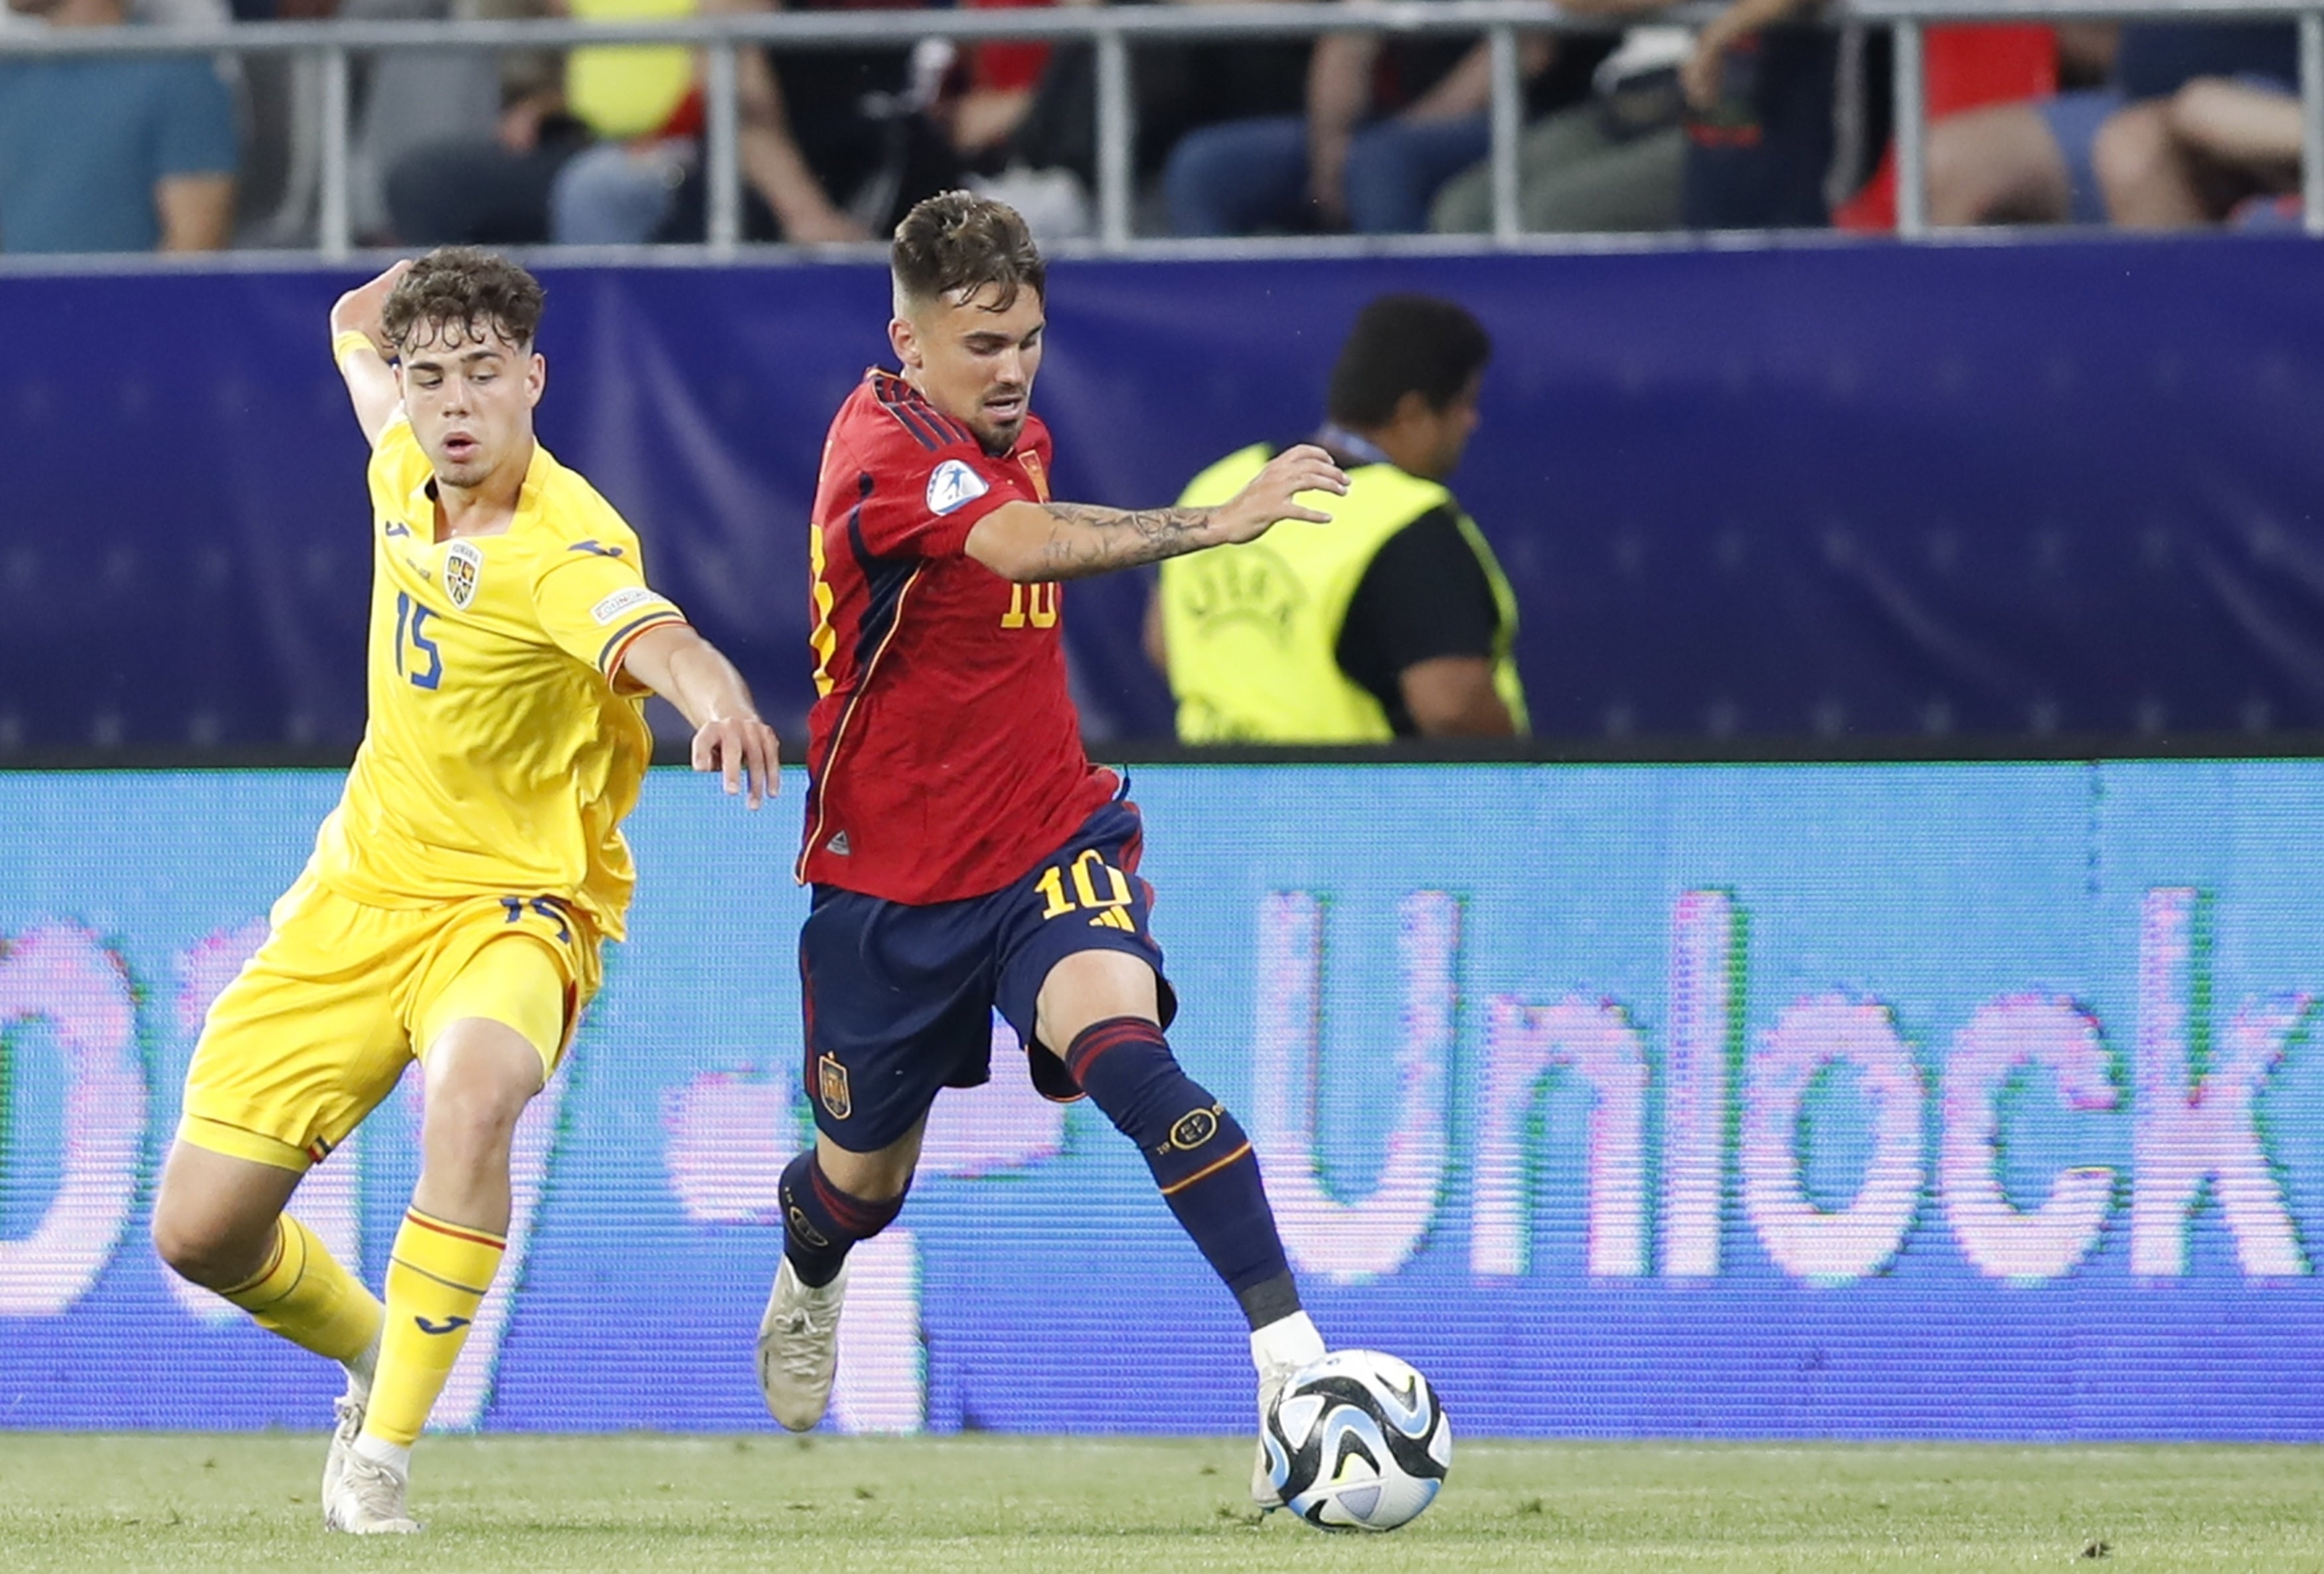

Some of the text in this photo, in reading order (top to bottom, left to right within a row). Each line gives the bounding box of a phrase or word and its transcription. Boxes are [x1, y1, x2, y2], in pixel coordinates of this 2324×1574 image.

[396, 591, 442, 690] 15
[1033, 849, 1133, 919] 10
[1256, 887, 2320, 1282] Unlock
